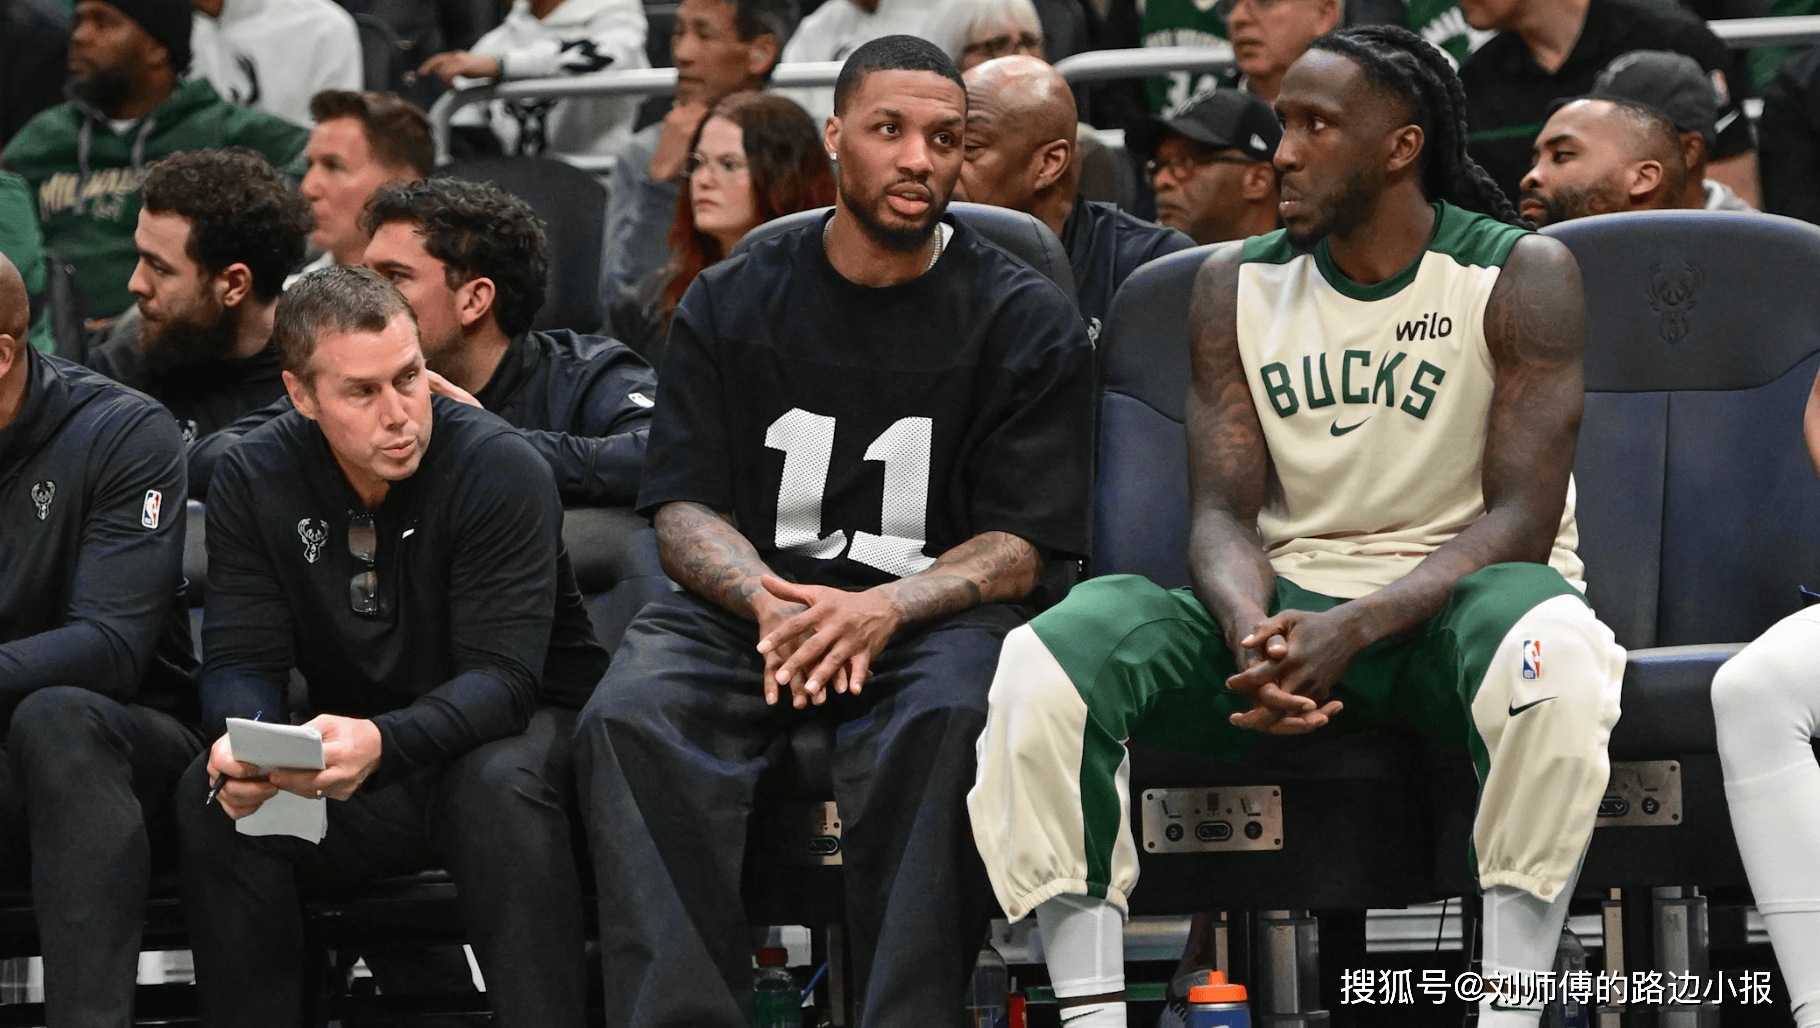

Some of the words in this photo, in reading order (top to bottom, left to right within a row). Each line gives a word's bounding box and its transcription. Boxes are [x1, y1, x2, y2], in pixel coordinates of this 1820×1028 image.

[1396, 312, 1452, 341] wilo
[1260, 350, 1446, 420] BUCKS
[764, 407, 938, 578] 11
